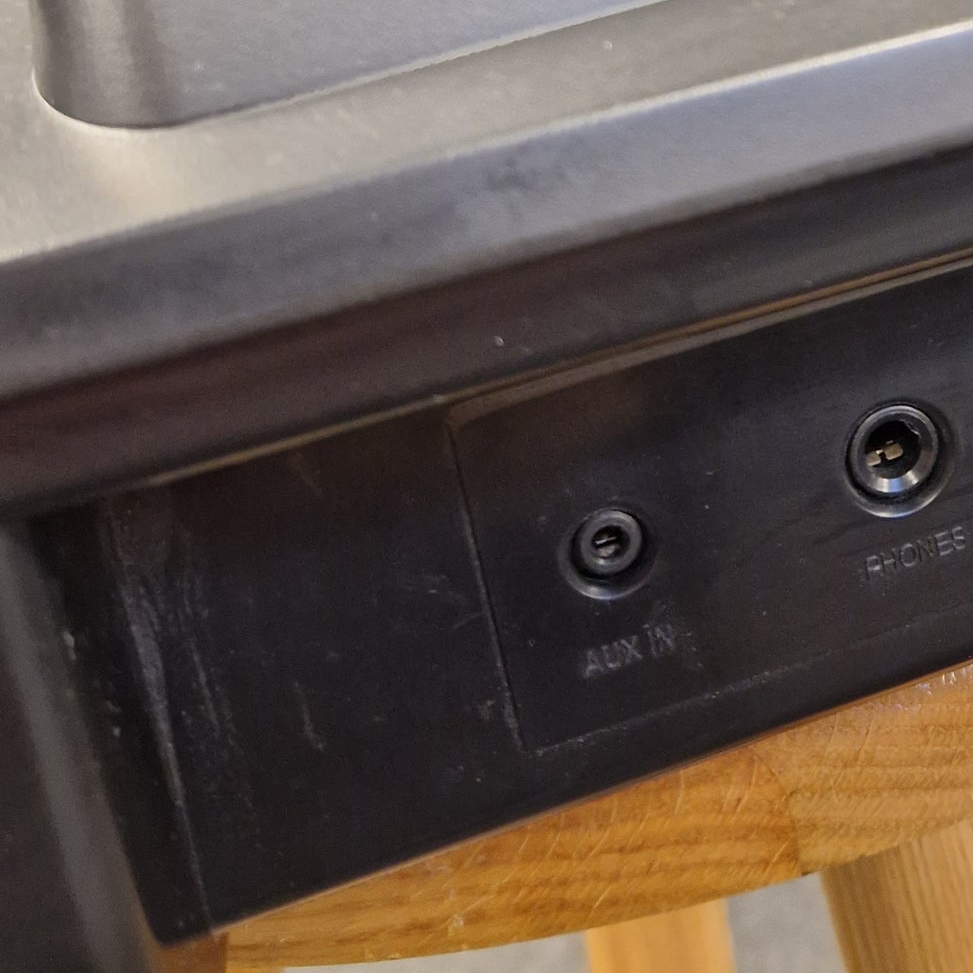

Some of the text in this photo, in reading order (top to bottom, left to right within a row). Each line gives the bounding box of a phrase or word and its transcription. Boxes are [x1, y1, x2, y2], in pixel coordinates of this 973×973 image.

[864, 524, 967, 581] PHONES
[583, 623, 674, 679] AUX IN
